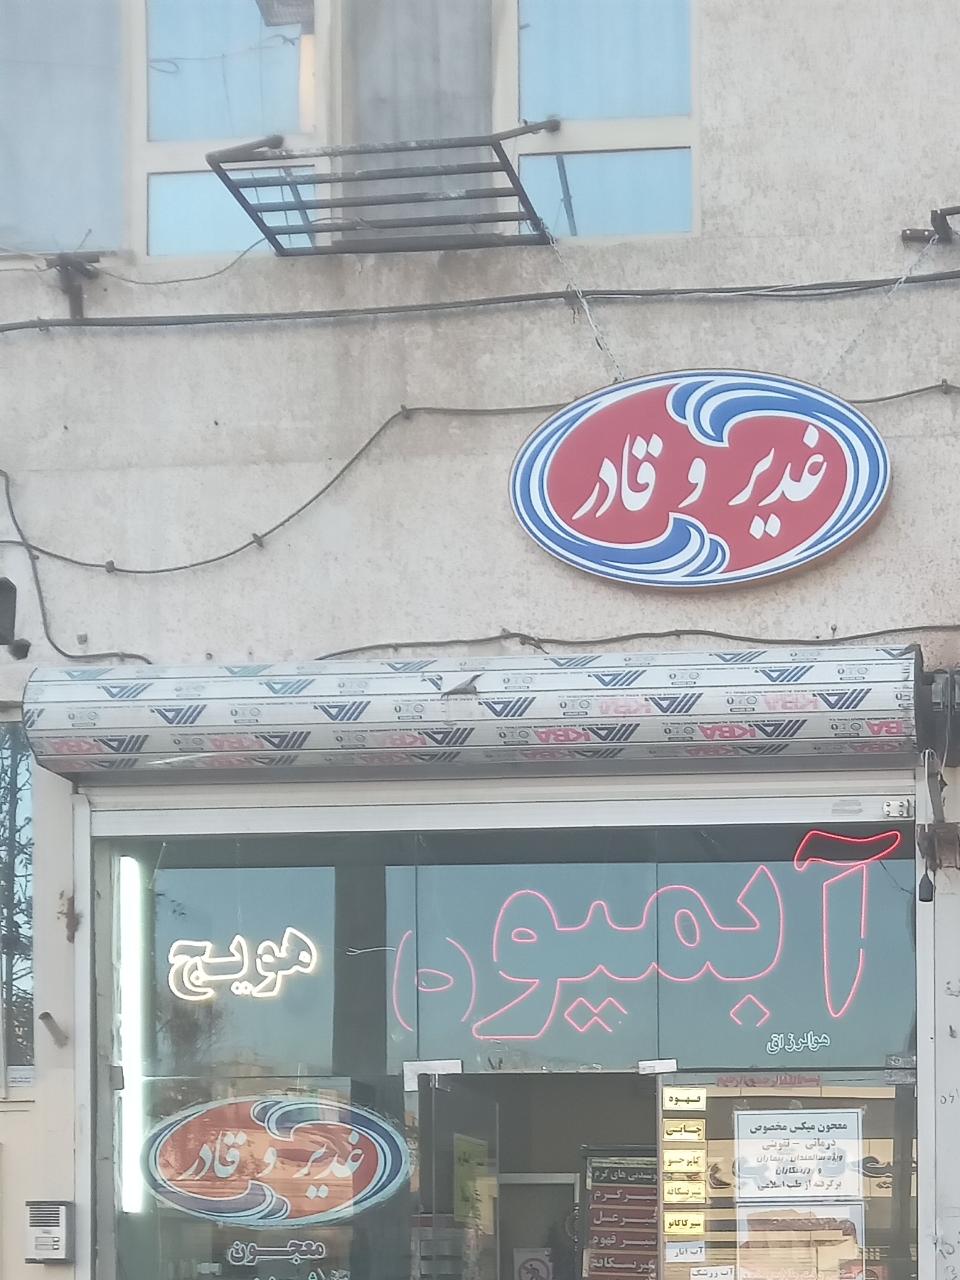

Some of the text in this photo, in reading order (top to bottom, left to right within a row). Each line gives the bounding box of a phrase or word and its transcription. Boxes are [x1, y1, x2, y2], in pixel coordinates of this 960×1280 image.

[572, 424, 828, 539] غدیر و قادر
[167, 926, 317, 1001] هویج
[180, 1130, 366, 1199] غدیر و قادر
[228, 1240, 326, 1264] معجون
[593, 1210, 619, 1225] عسل
